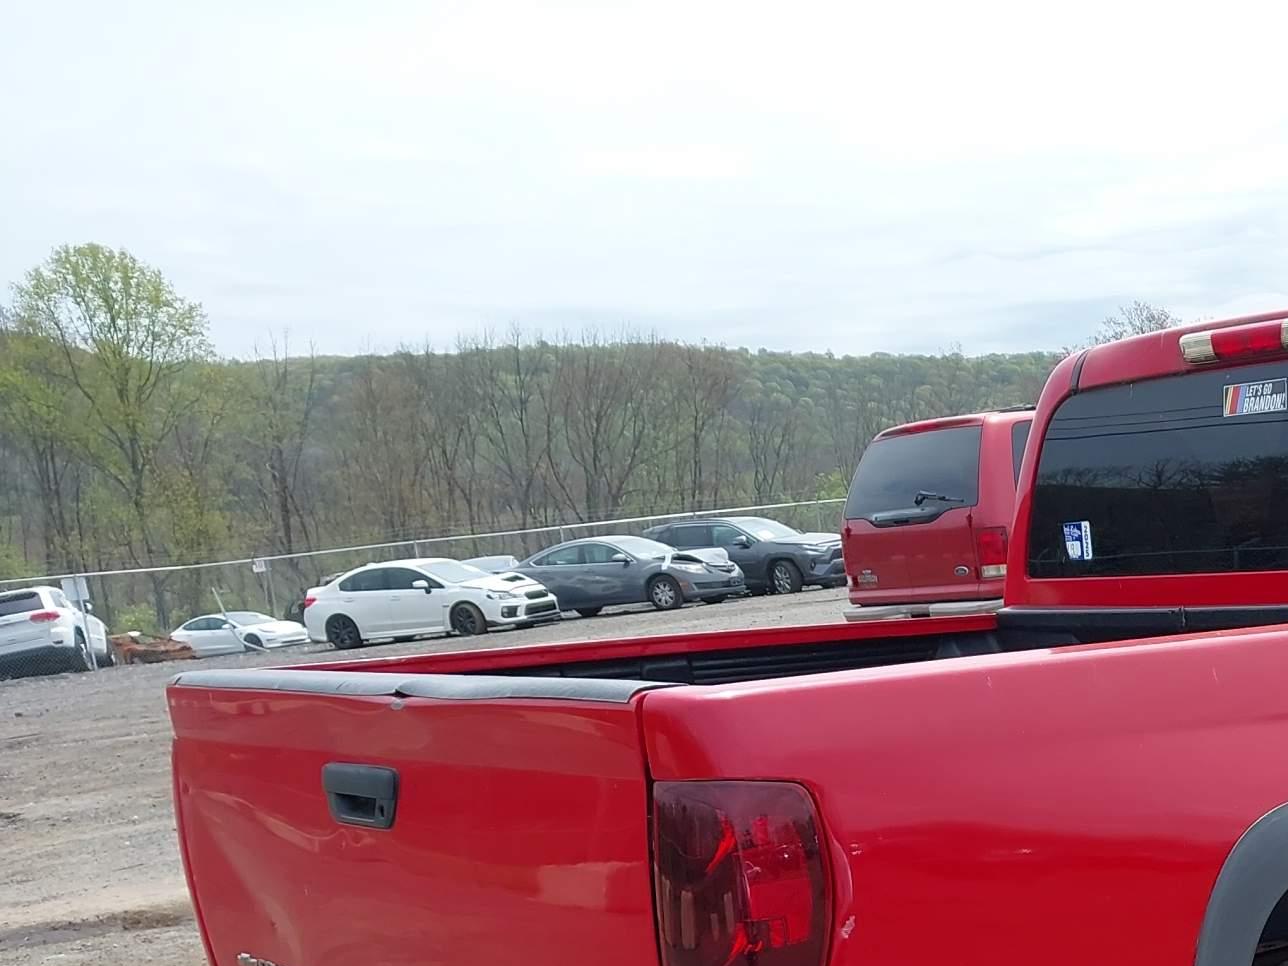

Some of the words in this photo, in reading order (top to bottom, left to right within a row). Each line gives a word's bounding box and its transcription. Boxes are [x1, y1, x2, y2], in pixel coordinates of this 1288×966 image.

[1246, 384, 1263, 397] LET'S
[1263, 383, 1273, 395] GO
[1243, 392, 1285, 413] BRANDON!
